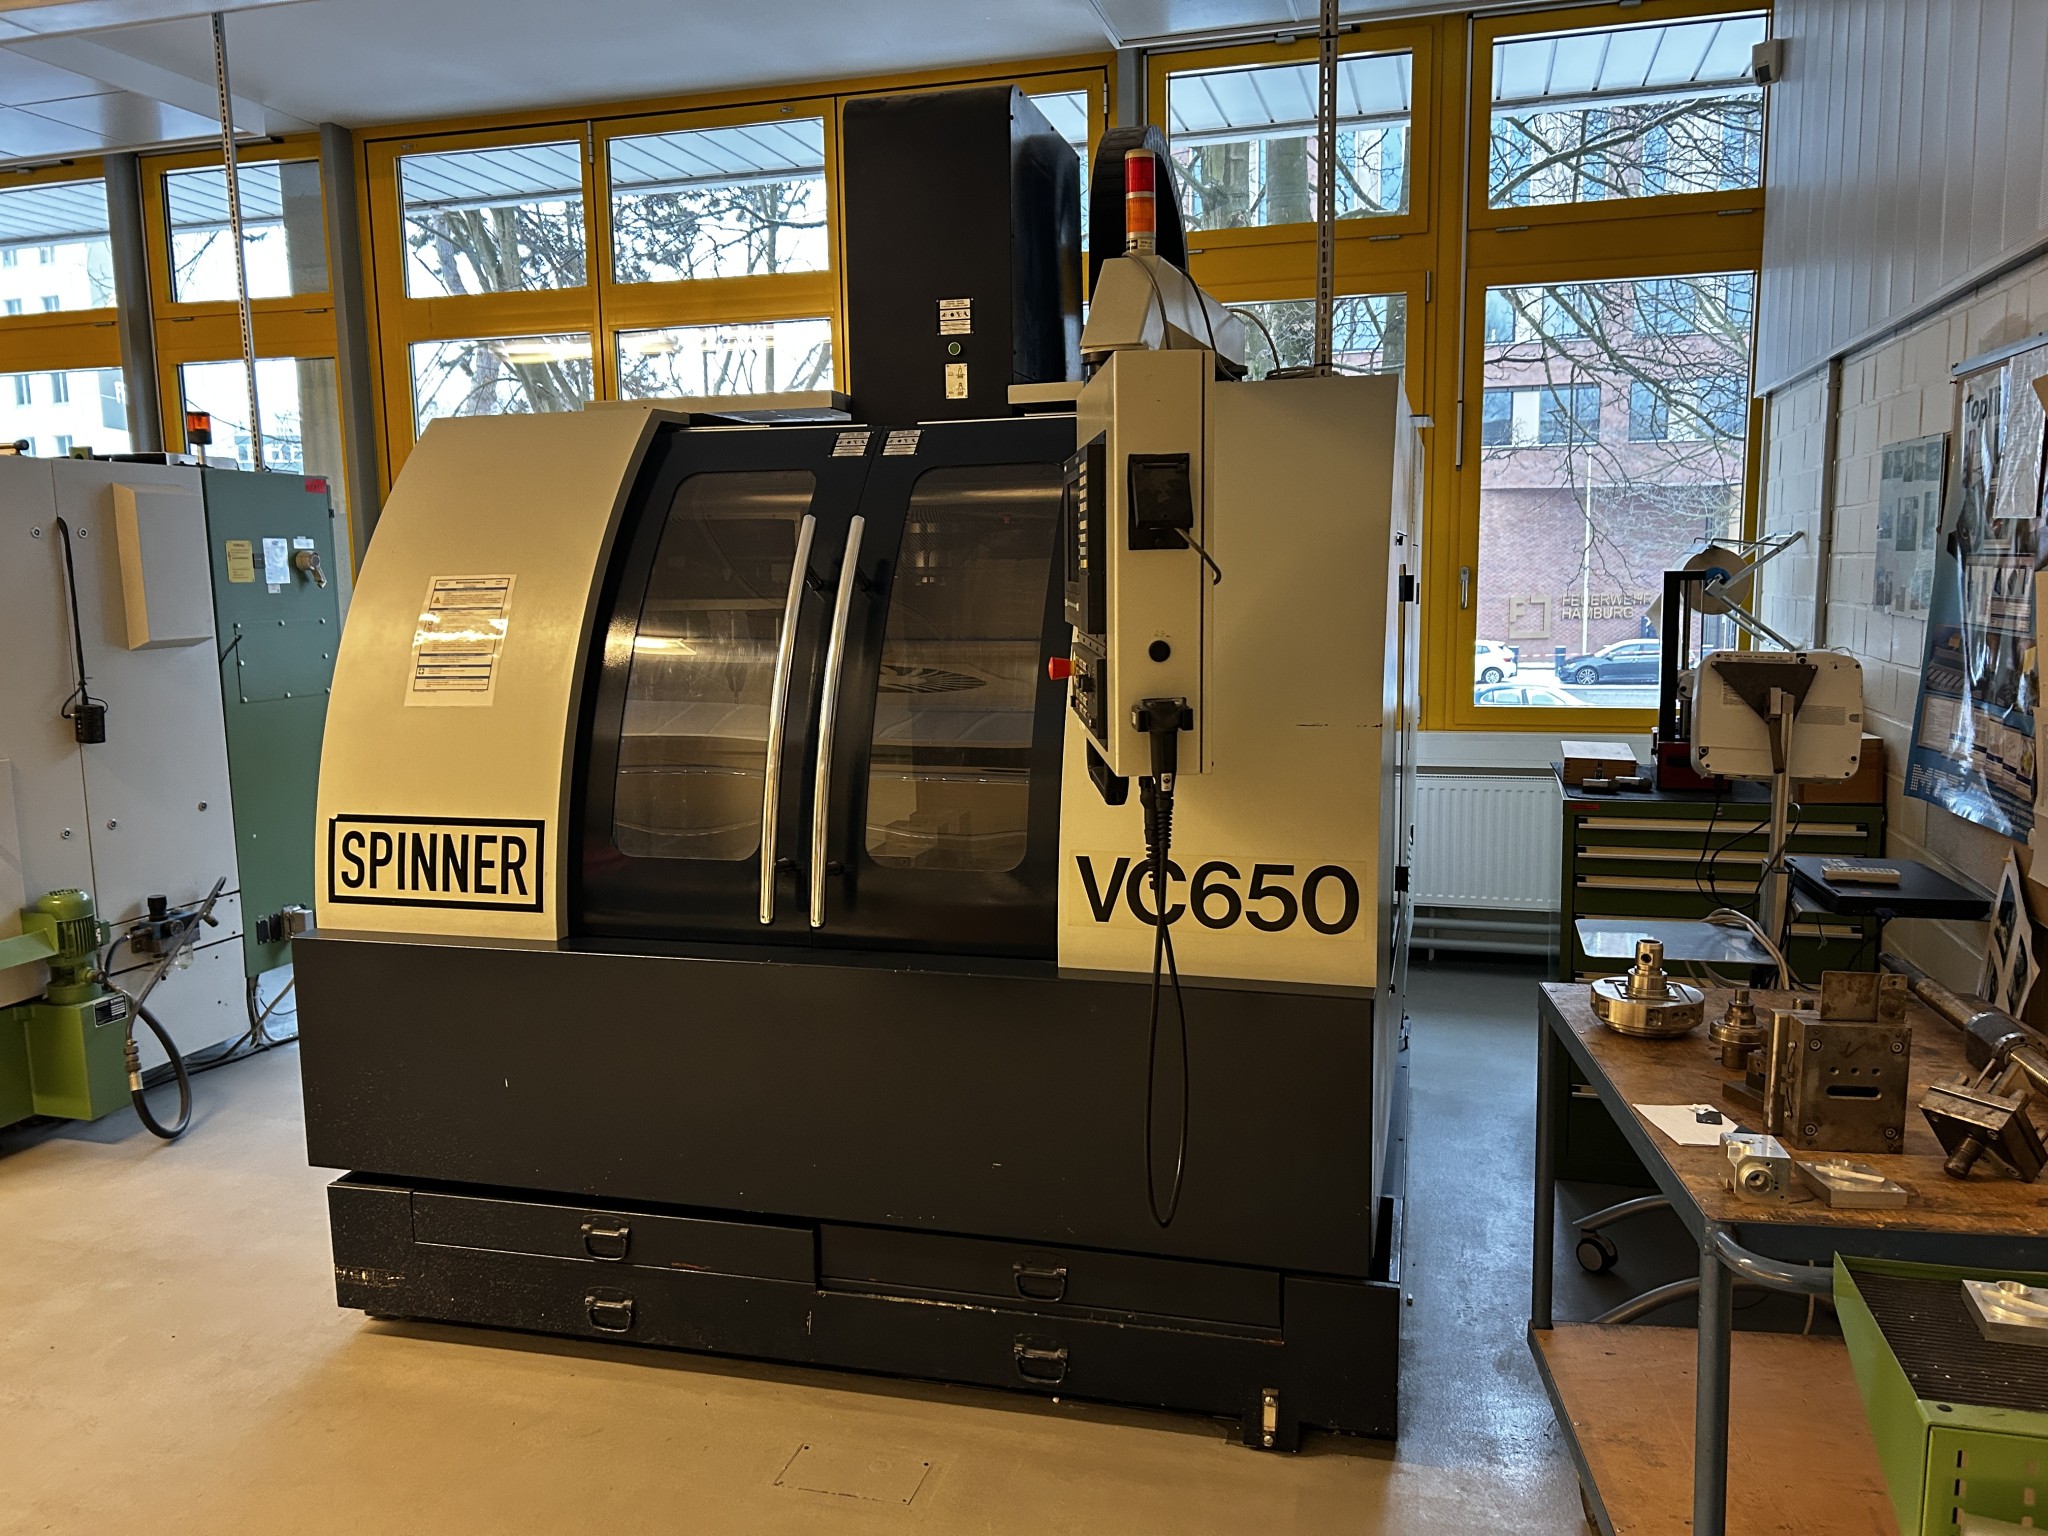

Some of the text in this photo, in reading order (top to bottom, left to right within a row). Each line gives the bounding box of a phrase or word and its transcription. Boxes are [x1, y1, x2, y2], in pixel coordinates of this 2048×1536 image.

[1561, 606, 1634, 619] HAMBURG
[341, 831, 528, 895] SPINNER
[1075, 855, 1360, 935] VC650
